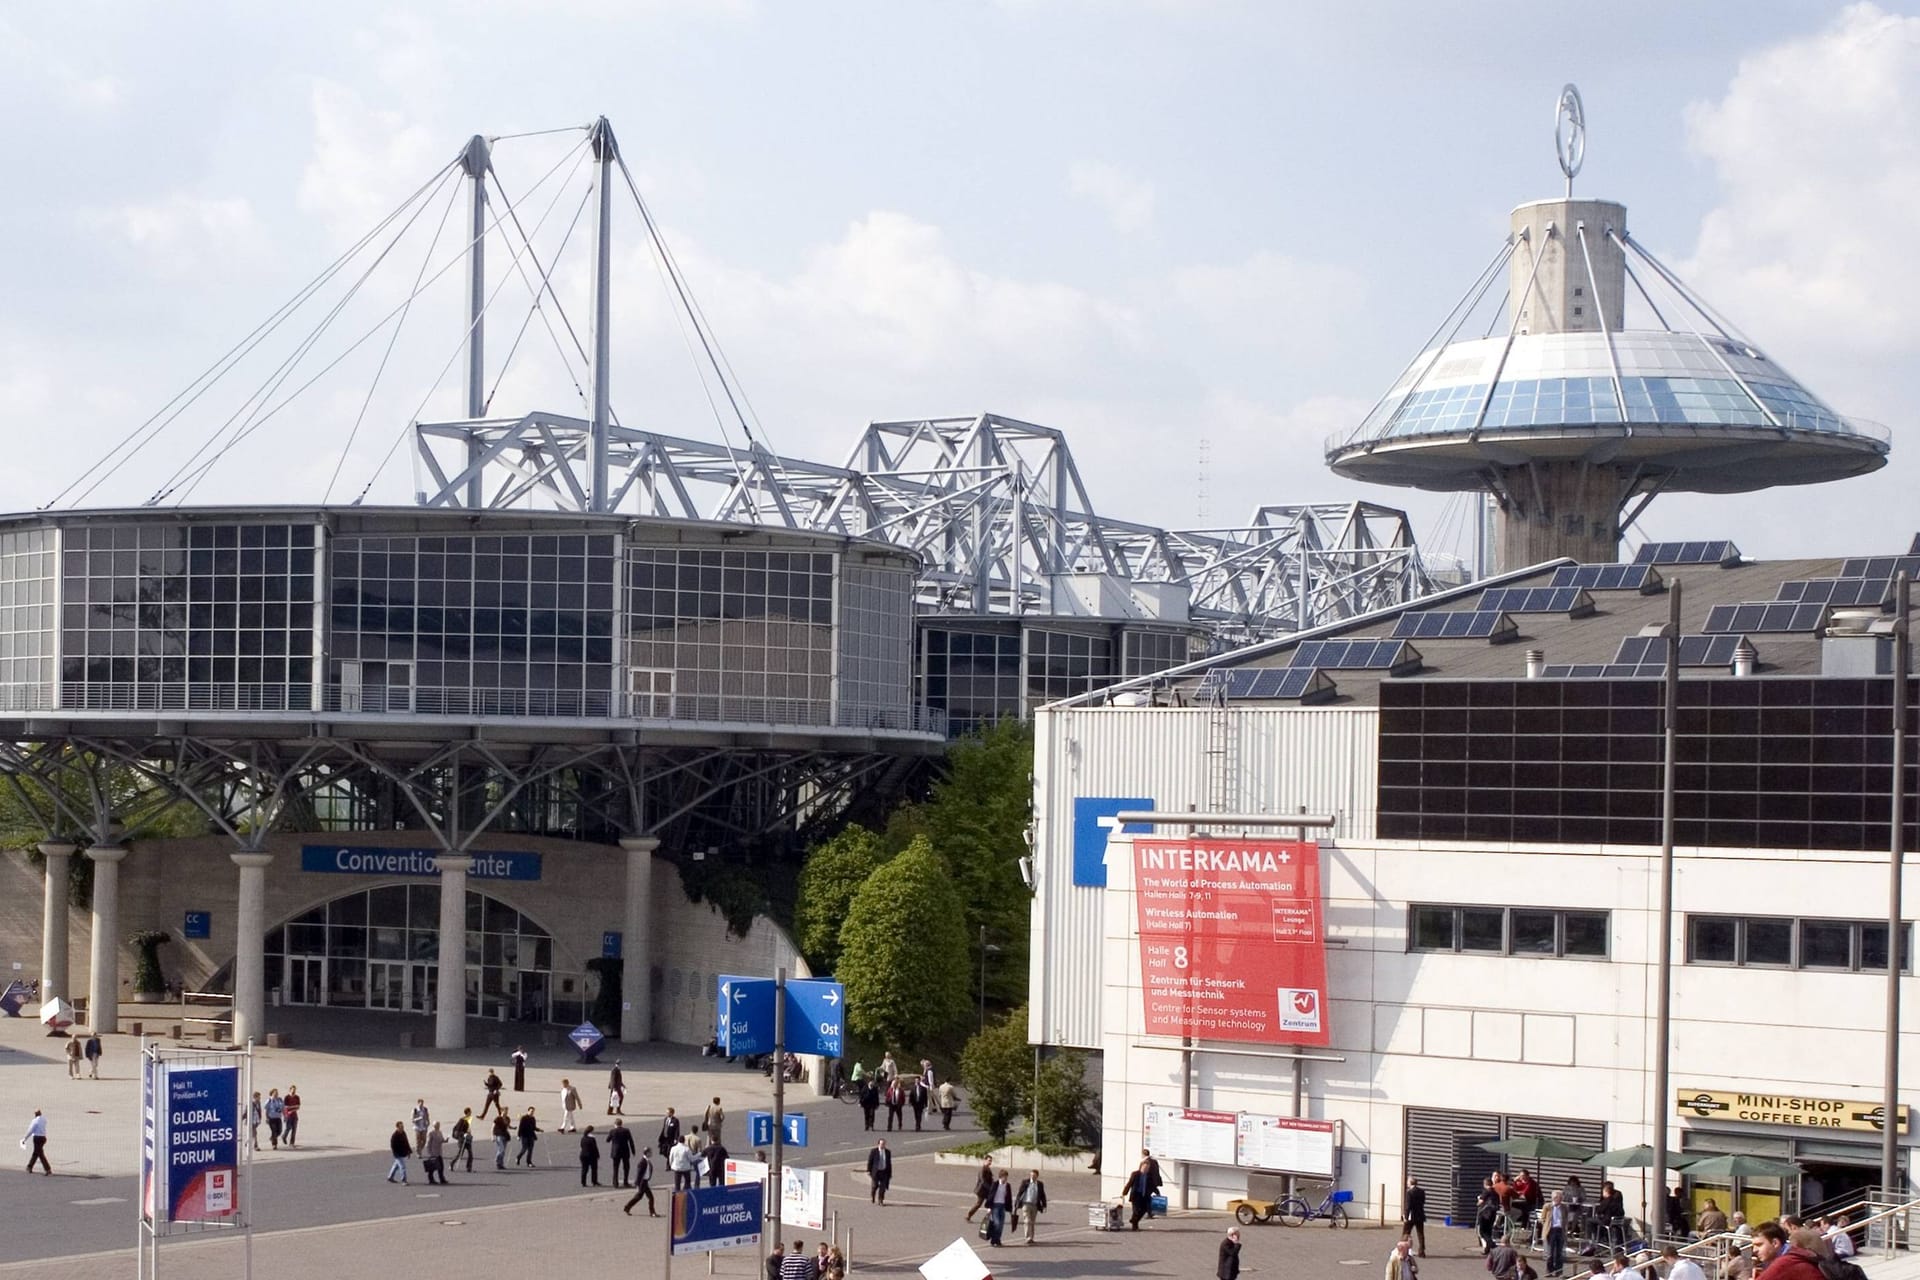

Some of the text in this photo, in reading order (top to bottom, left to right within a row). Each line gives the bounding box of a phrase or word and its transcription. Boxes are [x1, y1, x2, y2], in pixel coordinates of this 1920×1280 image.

[336, 849, 514, 876] Conventio enter
[1143, 878, 1293, 891] The World of Process Automation
[1144, 890, 1167, 899] Hallen
[1205, 892, 1211, 900] 11
[187, 914, 199, 924] CC
[1145, 908, 1238, 920] Wireless Automation
[1168, 921, 1184, 929] Hall
[1148, 945, 1188, 969] Halle 8
[1149, 957, 1166, 968] Hall
[1150, 975, 1246, 989] Zentrum für Sensorik
[1151, 987, 1225, 1000] und Messtechnik
[1151, 1002, 1267, 1020] Centre for Sensor systems
[732, 1021, 748, 1035] Süd
[820, 1022, 839, 1036] Ost
[1152, 1015, 1266, 1031] and Measuring technology
[1283, 1019, 1317, 1028] Zentrum
[732, 1038, 756, 1051] South
[817, 1038, 839, 1051] East
[173, 1081, 193, 1090] Hall 11
[173, 1090, 208, 1099] Pavilion A-C
[1737, 1095, 1845, 1113] MINI-SHOP
[173, 1109, 221, 1125] GLOBAL
[1739, 1110, 1842, 1127] COFFEE BAR
[173, 1127, 233, 1145] BUSINESS
[173, 1149, 216, 1166] FORUM
[702, 1202, 744, 1215] MAKE IT WORK
[719, 1210, 752, 1225] KOREA
